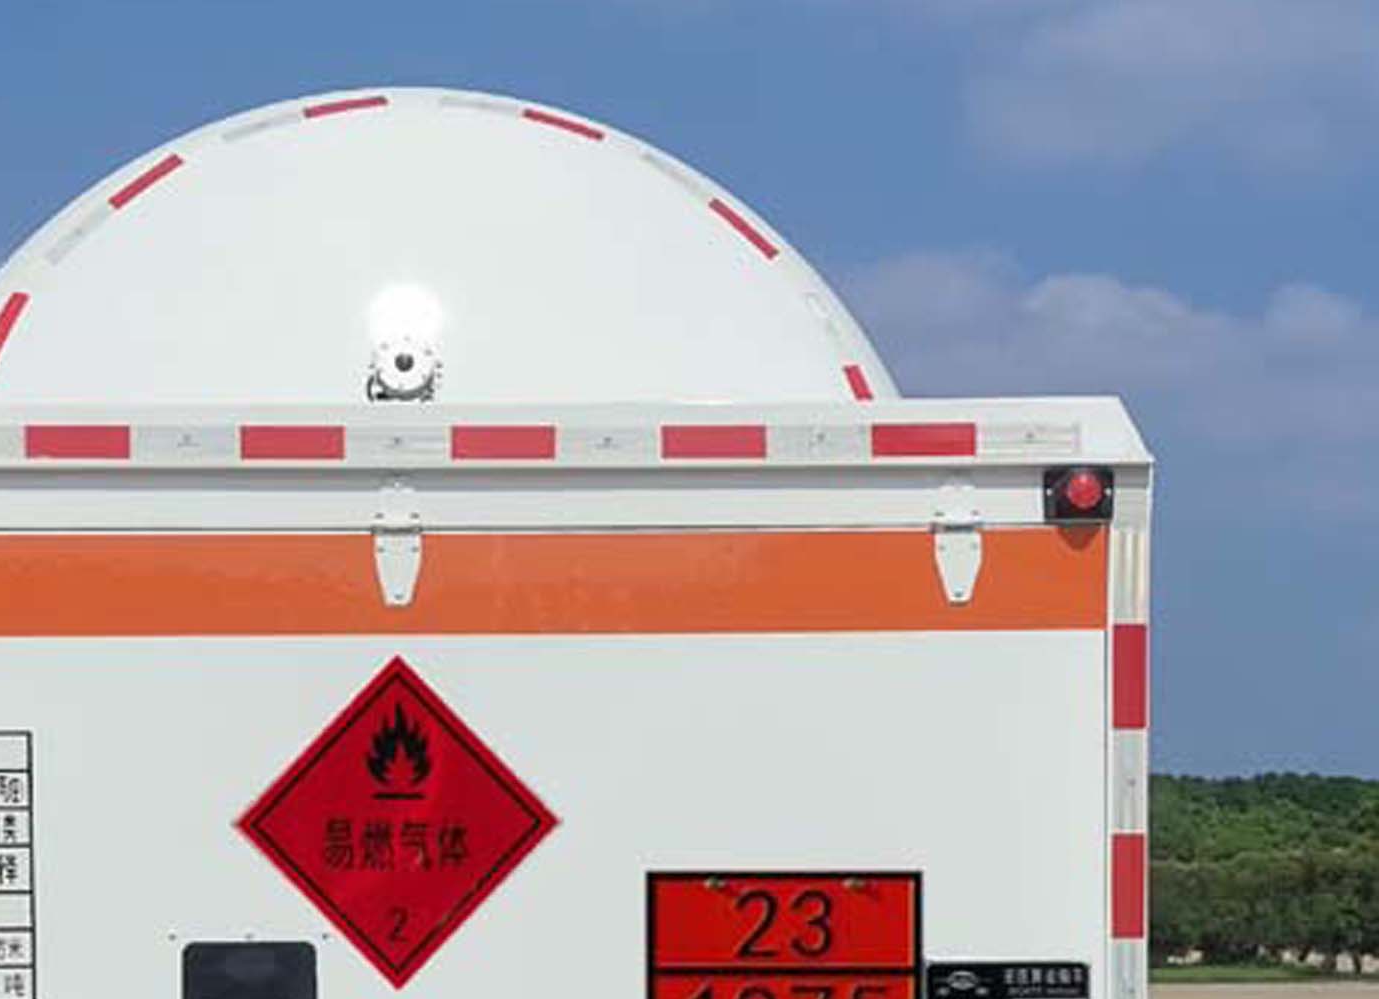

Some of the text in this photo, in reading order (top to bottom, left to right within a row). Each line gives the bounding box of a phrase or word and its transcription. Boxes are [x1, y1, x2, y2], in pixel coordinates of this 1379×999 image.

[323, 818, 470, 872] 易燃气体
[387, 906, 410, 943] 2
[733, 889, 833, 958] 23
[3, 973, 26, 998] 吨
